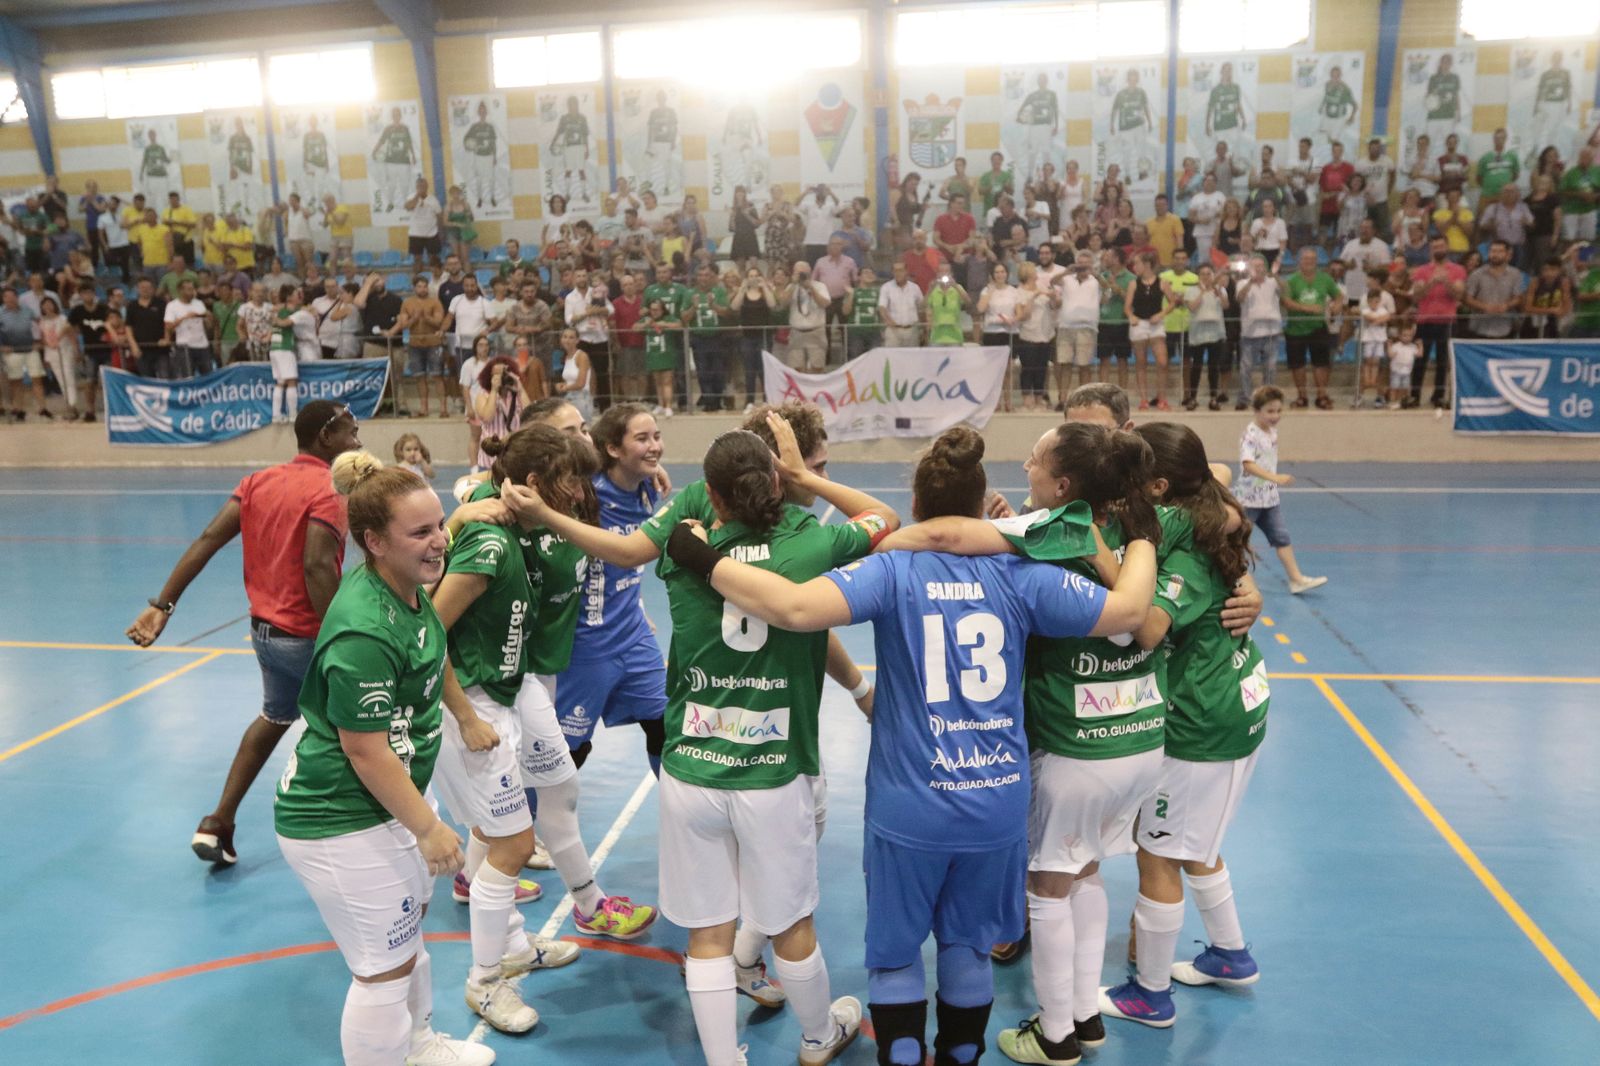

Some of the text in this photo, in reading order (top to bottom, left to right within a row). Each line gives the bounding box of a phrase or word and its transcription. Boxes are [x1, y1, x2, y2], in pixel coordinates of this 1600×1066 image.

[780, 357, 981, 414] Andalucía
[1559, 394, 1593, 418] de
[181, 408, 261, 434] de Cádiz
[927, 582, 984, 600] SANDRA
[923, 612, 1007, 703] 13
[687, 705, 784, 738] Andalucía
[674, 744, 787, 767] AYTO.GUADALCACIN
[930, 743, 1018, 773] Andalucía
[929, 773, 1020, 791] AYTO.GUADALCACIN
[1155, 799, 1168, 819] 2
